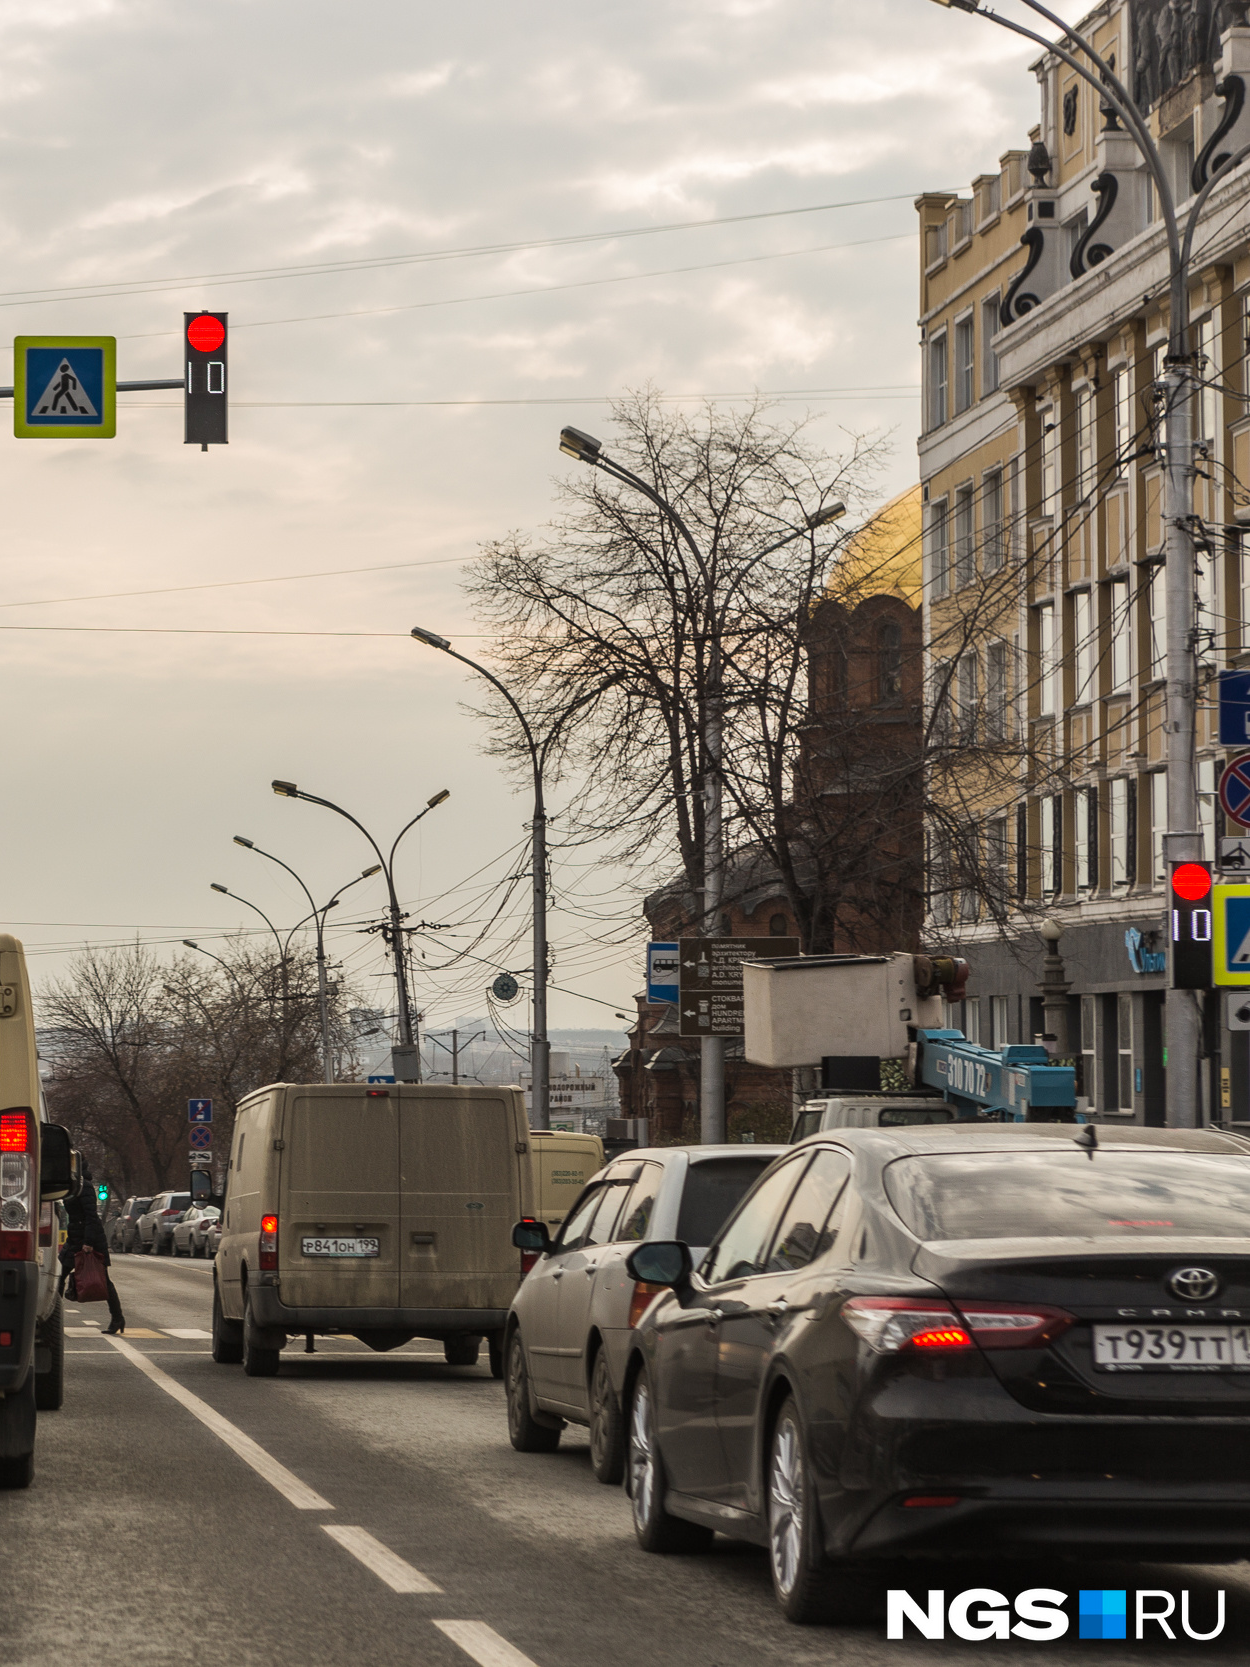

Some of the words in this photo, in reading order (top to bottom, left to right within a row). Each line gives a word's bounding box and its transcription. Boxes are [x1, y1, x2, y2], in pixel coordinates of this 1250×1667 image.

[188, 361, 225, 394] 10
[1172, 909, 1211, 941] 10
[711, 1024, 741, 1032] building
[947, 1053, 963, 1090] 310
[964, 1060, 975, 1094] 70
[975, 1063, 986, 1097] 72
[1117, 1308, 1241, 1317] CAMR
